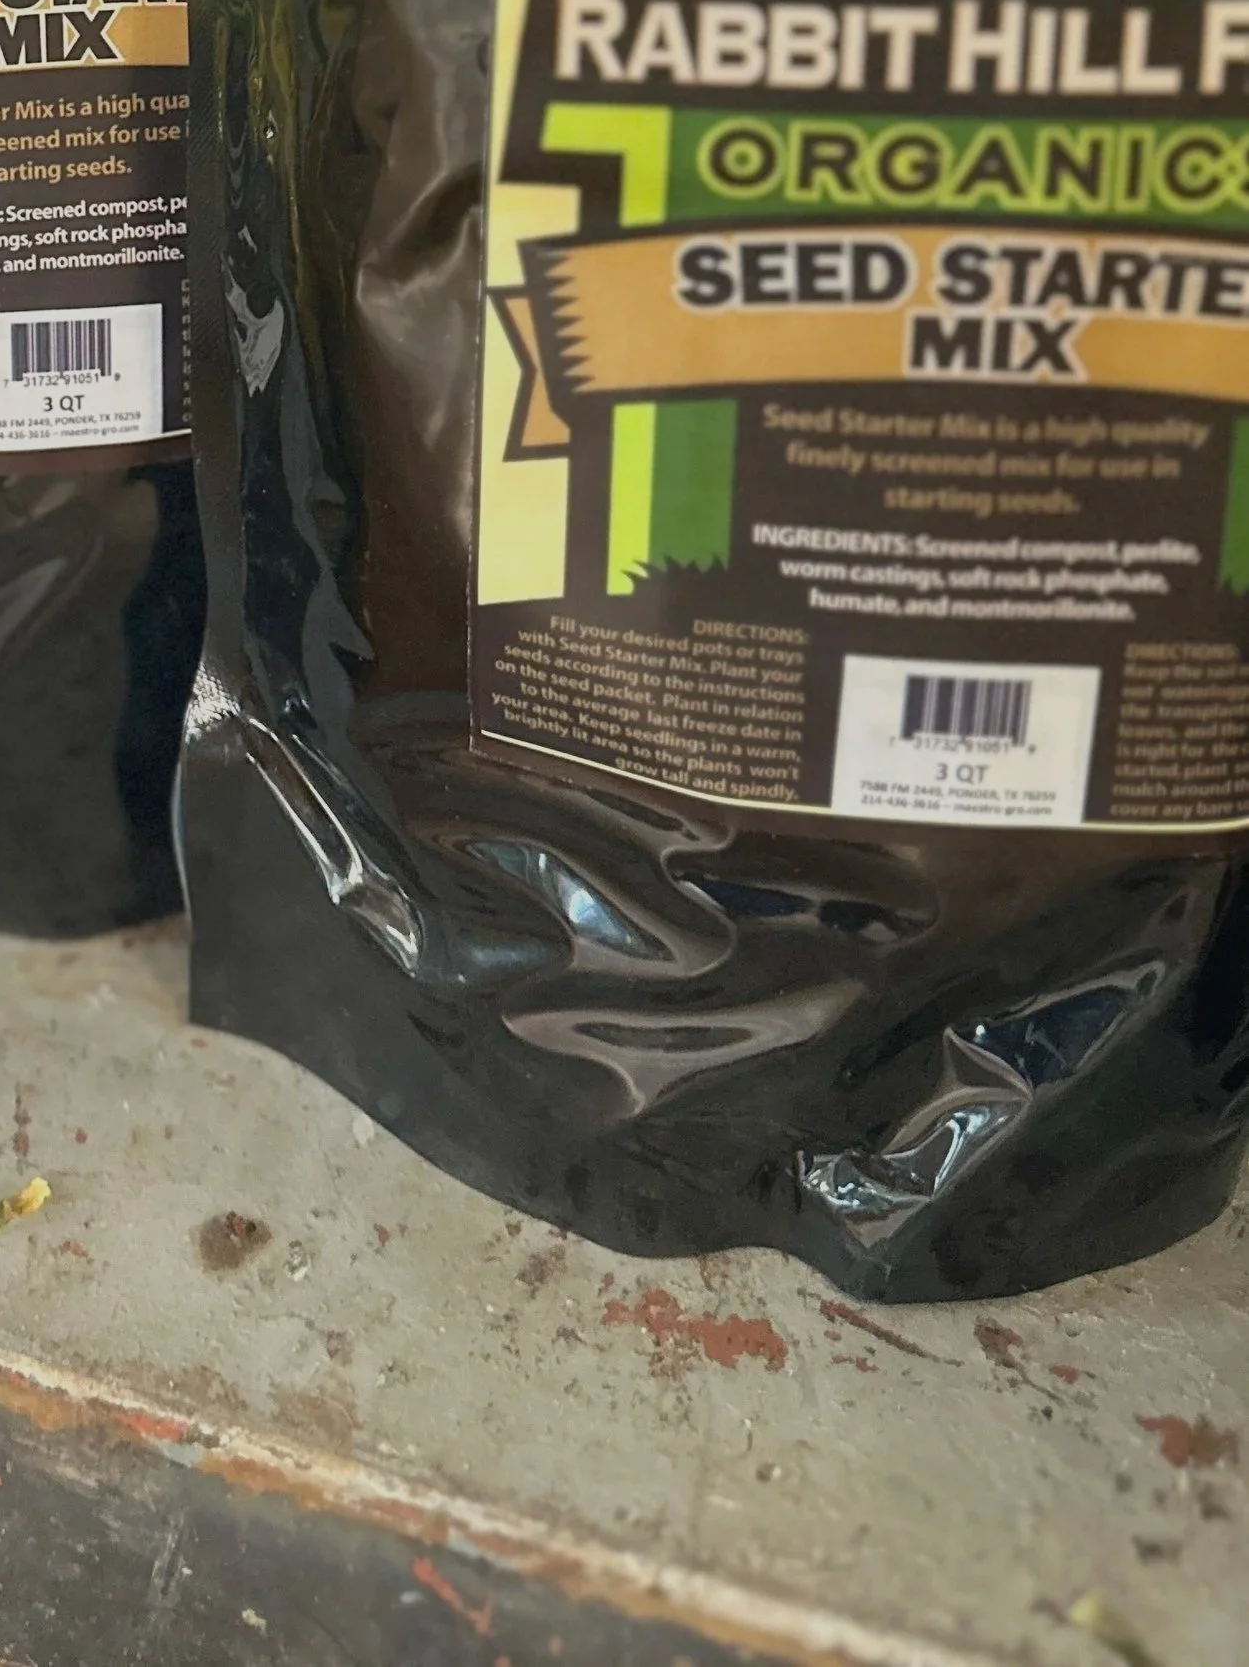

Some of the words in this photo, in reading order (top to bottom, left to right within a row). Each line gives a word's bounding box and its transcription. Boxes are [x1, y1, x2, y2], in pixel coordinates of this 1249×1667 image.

[15, 100, 54, 121] Mix
[59, 99, 76, 117] is
[80, 103, 93, 116] a
[97, 93, 145, 118] high
[65, 127, 105, 148] mix
[108, 124, 140, 144] for
[144, 124, 181, 141] use
[66, 156, 133, 176] seeds.
[700, 121, 1249, 211] ORGANIC
[6, 200, 86, 223] Screened
[89, 196, 168, 218] compost,
[35, 227, 67, 246] soft
[71, 224, 110, 243] rock
[111, 219, 187, 244] phospha
[3, 254, 37, 272] and
[39, 245, 186, 270] montmorillonite.
[675, 241, 914, 310] SEED
[936, 242, 1249, 318] STARTE
[910, 315, 1079, 372] MIX
[43, 396, 54, 412] 3
[59, 394, 87, 413] QT
[10, 418, 25, 428] FM
[55, 414, 96, 427] PONDER,
[98, 413, 111, 423] TX
[762, 403, 833, 433] Seed
[839, 407, 932, 437] Starter
[939, 411, 990, 439] Mix
[995, 414, 1018, 442] is
[1022, 420, 1041, 443] a
[1044, 413, 1107, 448] high
[1111, 415, 1211, 450] quality
[786, 439, 867, 476] finely
[871, 449, 997, 477] screened
[999, 453, 1050, 477] mix
[1055, 451, 1093, 478] for
[1099, 458, 1148, 478] use
[1152, 454, 1181, 479] in
[883, 486, 993, 518] starting
[997, 487, 1081, 513] seeds.
[751, 523, 912, 556] INGREDIENTS:
[914, 533, 1020, 561] Screened
[1021, 539, 1120, 566] compost,
[1121, 537, 1204, 567] perlite,
[779, 560, 848, 581] worm
[849, 563, 945, 593] castings,
[948, 565, 990, 590] soft
[993, 566, 1042, 591] rock
[1044, 567, 1169, 595] phosphate,
[809, 586, 902, 616] humate,
[903, 595, 949, 618] and
[950, 596, 1137, 622] montmorillonite.
[934, 762, 949, 782] 3
[955, 763, 990, 785] QT
